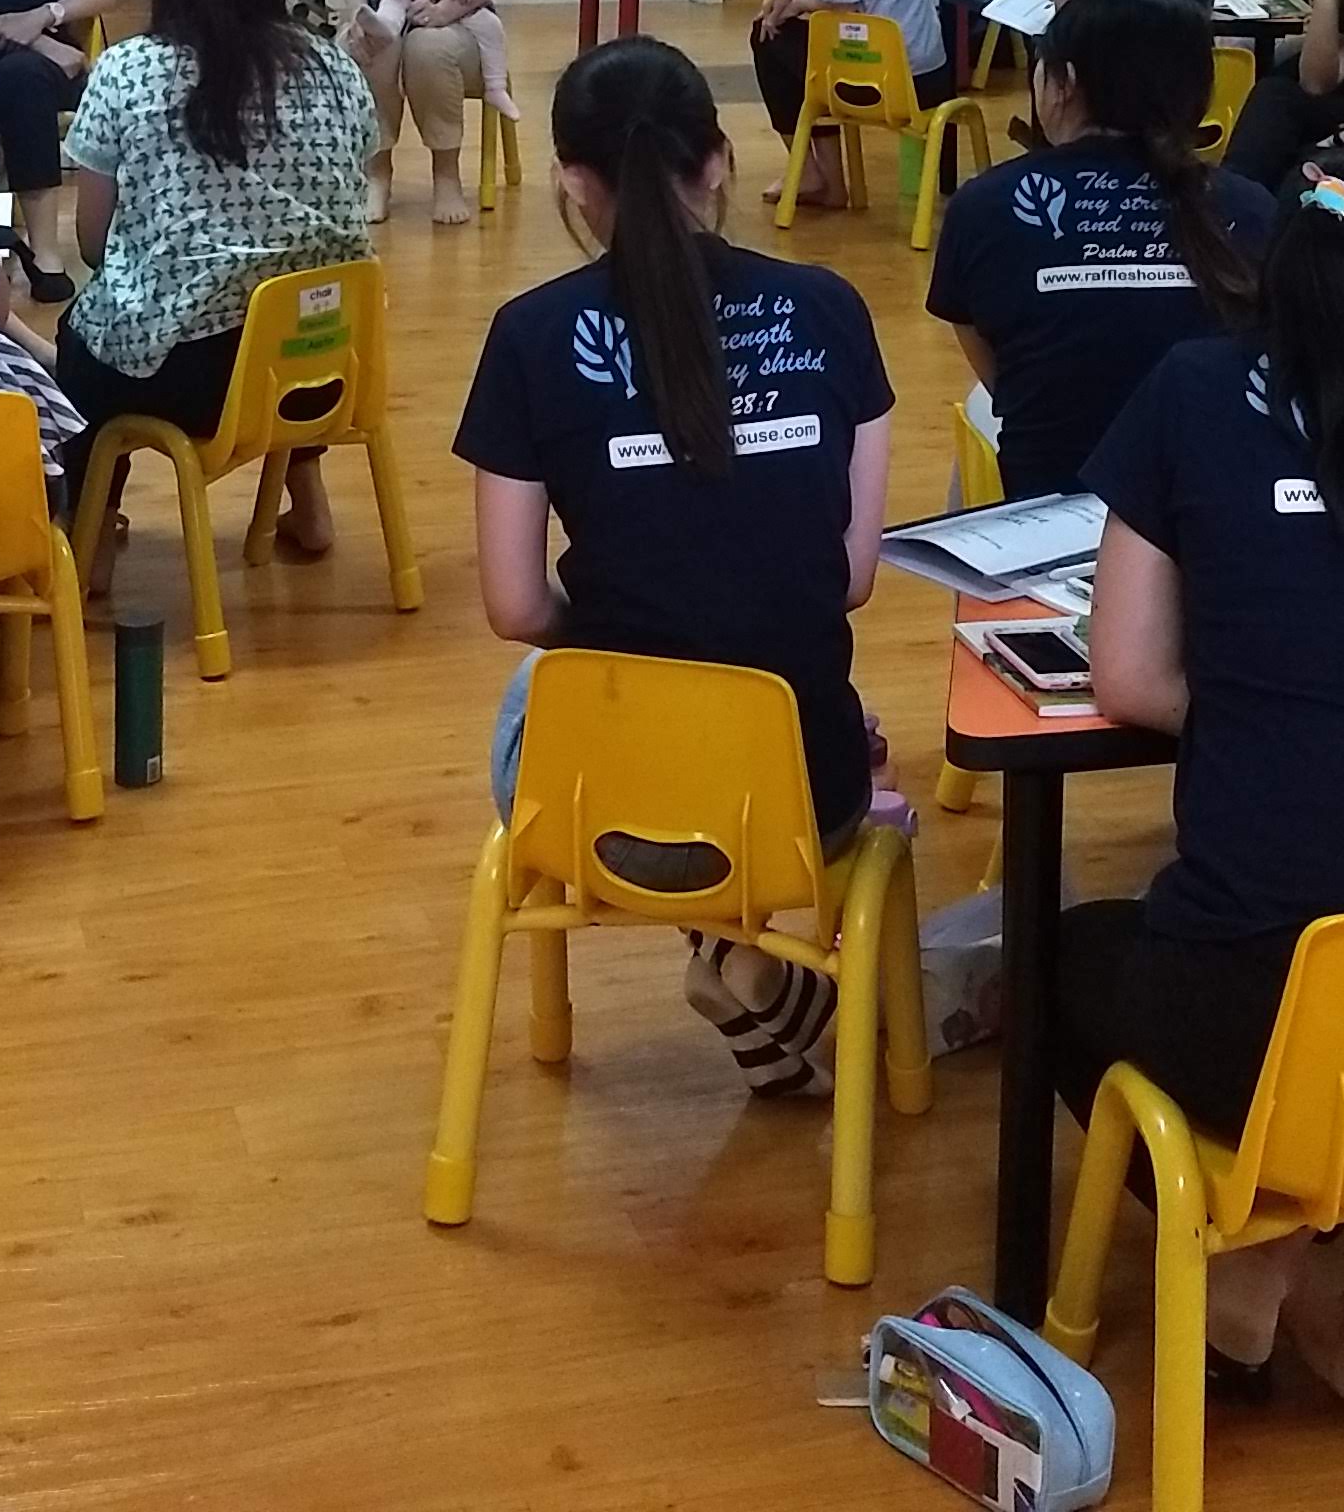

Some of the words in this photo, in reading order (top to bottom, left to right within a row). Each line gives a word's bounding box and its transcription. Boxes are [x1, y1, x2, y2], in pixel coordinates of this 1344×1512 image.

[1075, 170, 1120, 192] The
[1075, 196, 1109, 215] my
[1077, 214, 1122, 234] and
[1130, 220, 1167, 239] my
[1082, 242, 1138, 261] Psalm
[1042, 269, 1193, 287] www.raffleshouse.
[310, 287, 332, 301] chair
[773, 293, 796, 317] is
[760, 347, 825, 376] shield
